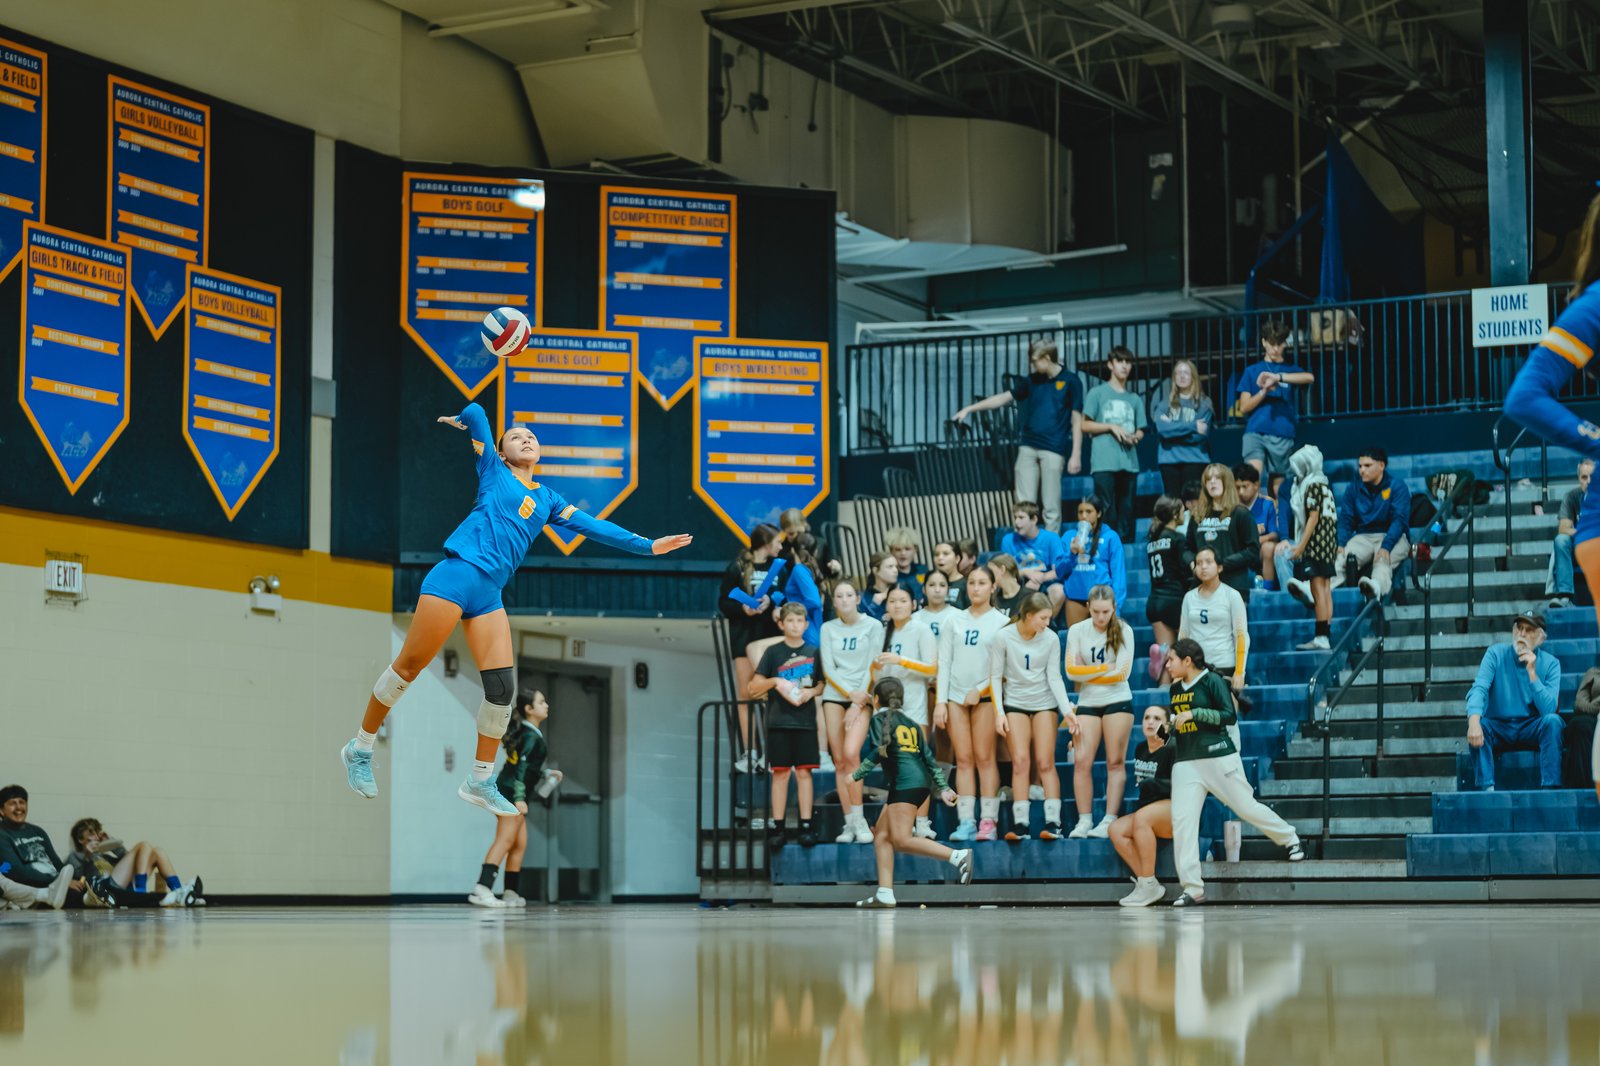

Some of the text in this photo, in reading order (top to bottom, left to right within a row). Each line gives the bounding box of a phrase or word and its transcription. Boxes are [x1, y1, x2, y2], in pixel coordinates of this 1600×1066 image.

[5, 51, 39, 70] CATHOLIC
[12, 71, 37, 90] FIELD
[117, 89, 202, 122] AURORA CENTRAL CATHOLIC
[120, 106, 198, 141] GIRLS VOLLEYBALL
[415, 182, 449, 192] AURORA
[451, 185, 488, 194] CENTRAL
[443, 198, 504, 213] BOYS GOLF
[612, 196, 726, 211] AURORA CENTRAL CATHOLIC
[613, 210, 725, 228] COMPETITIVE DANCE
[32, 233, 123, 264] AURORA CENTRAL CATHOLIC
[31, 250, 123, 284] GIRLS TRACK & FIELD
[194, 276, 217, 290] AURORA
[219, 283, 245, 297] CENTRAL
[198, 294, 269, 322] BOYS VOLLEYBALL
[1491, 293, 1528, 312] HOME
[1479, 318, 1542, 339] STUDENTS
[546, 338, 584, 349] CENTRAL
[586, 341, 628, 351] CATHOLIC
[704, 346, 818, 360] AURORA CENTRAL CATHOLIC
[537, 353, 600, 366] GIRLS GOLF
[714, 362, 808, 377] BOYS WRESTLING
[518, 495, 537, 519] 6
[1150, 553, 1164, 578] 13
[57, 565, 77, 588] EXIT
[1200, 609, 1208, 624] 5
[842, 637, 857, 651] 10
[964, 629, 980, 646] 12
[1024, 654, 1030, 671] 1
[1090, 646, 1105, 663] 14
[1171, 692, 1194, 704] SAINT
